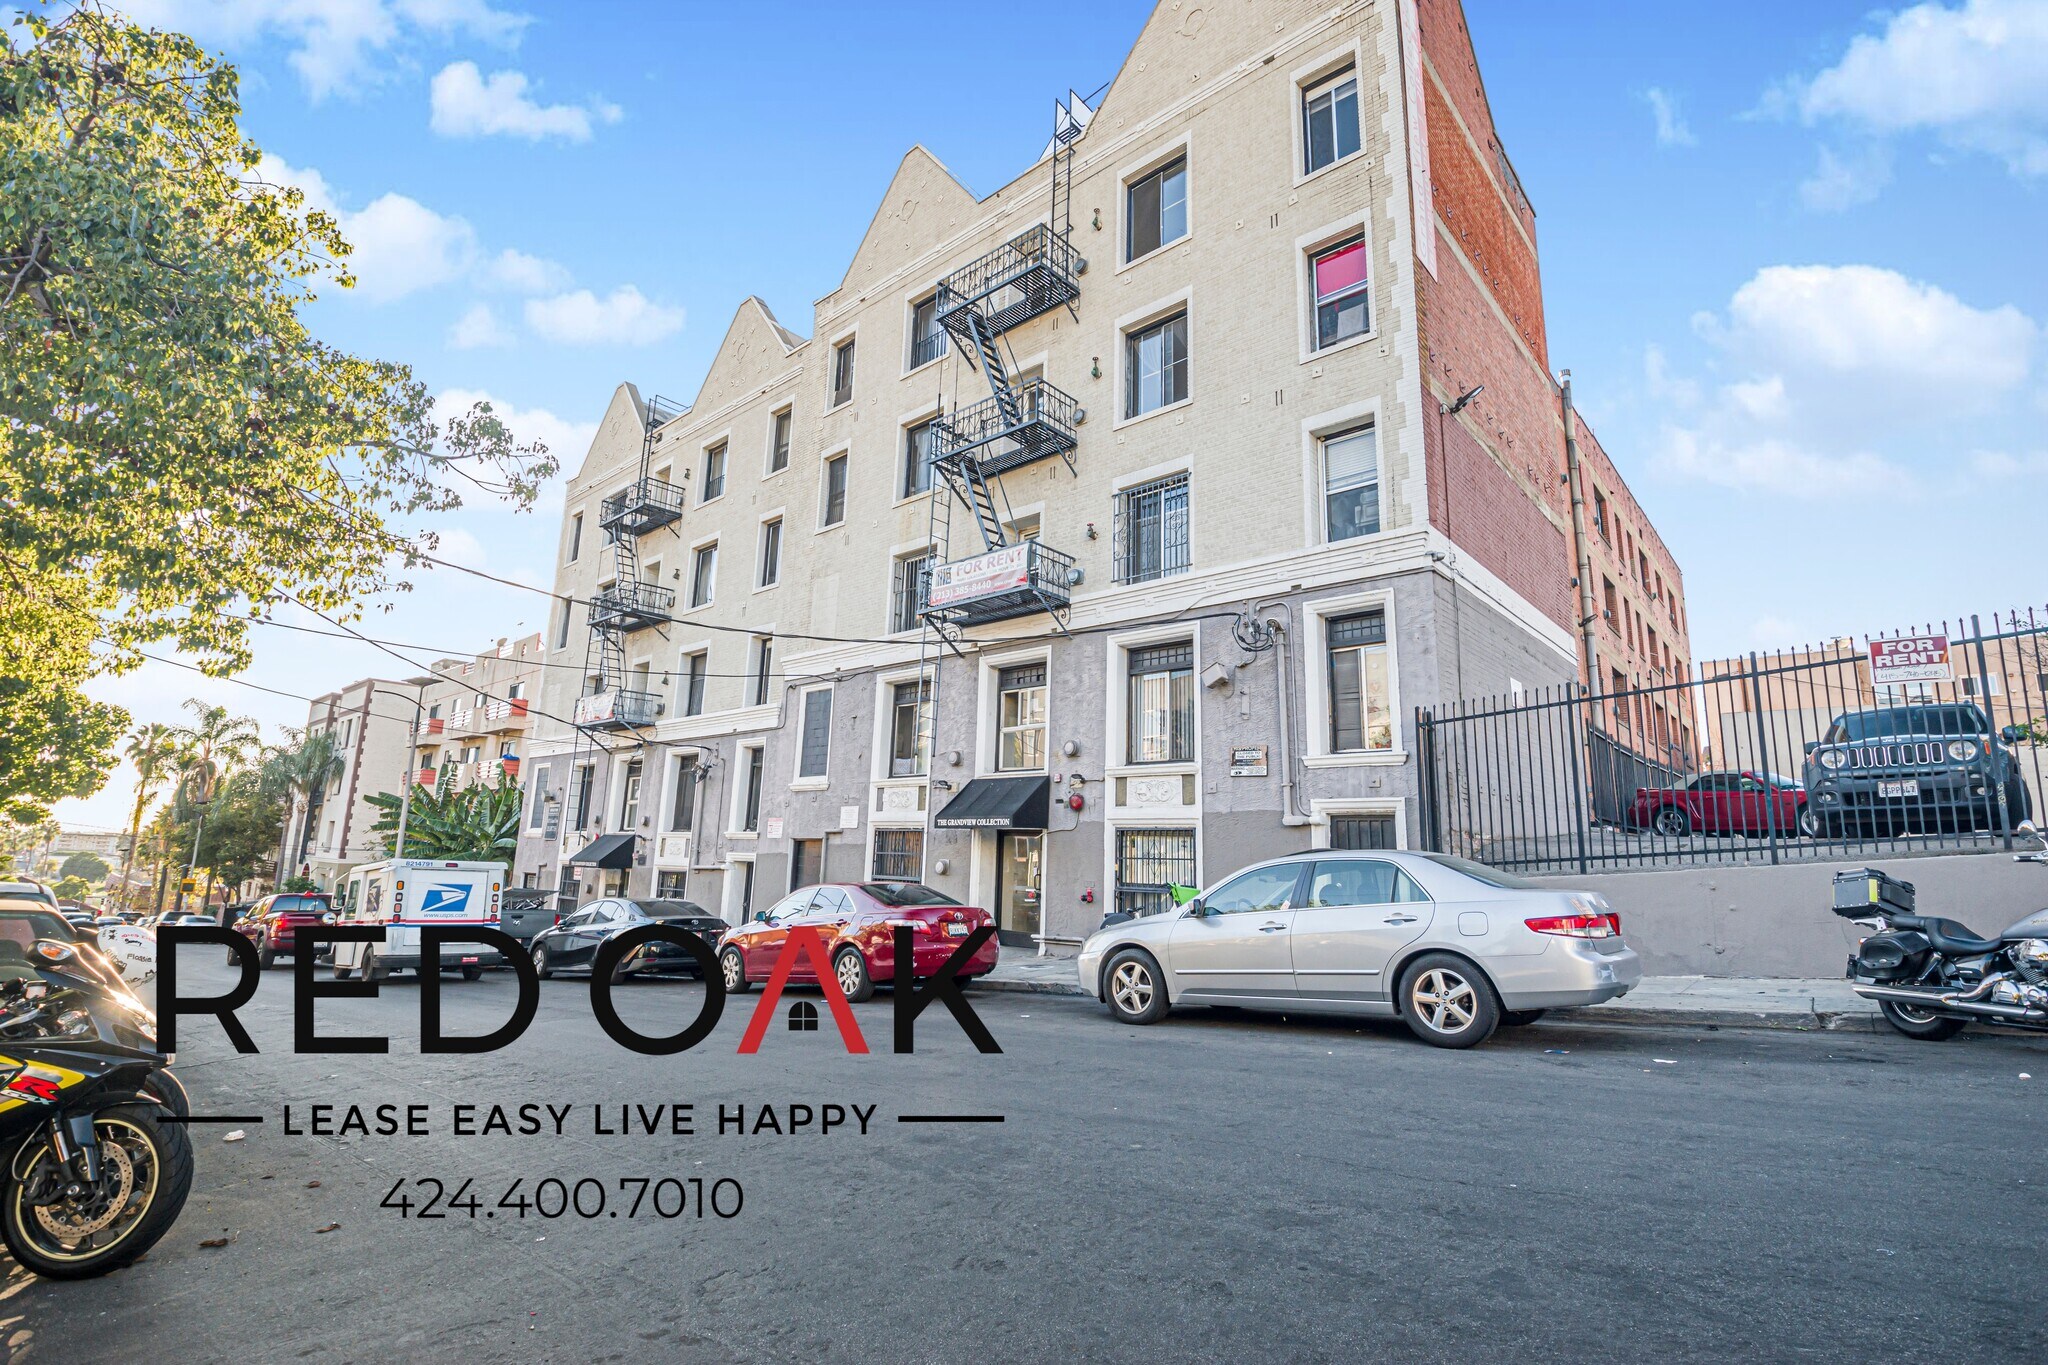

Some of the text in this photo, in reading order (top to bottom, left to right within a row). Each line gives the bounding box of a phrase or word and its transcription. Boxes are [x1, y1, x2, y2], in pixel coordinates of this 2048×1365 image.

[956, 560, 982, 576] FOR
[987, 547, 1024, 569] RENT
[932, 589, 953, 601] (213)
[955, 580, 991, 594] 385-8440
[1881, 639, 1934, 654] FOR
[1875, 651, 1944, 667] RENT
[947, 818, 976, 826] GRANDVIEW
[977, 818, 1010, 826] COLLECTION
